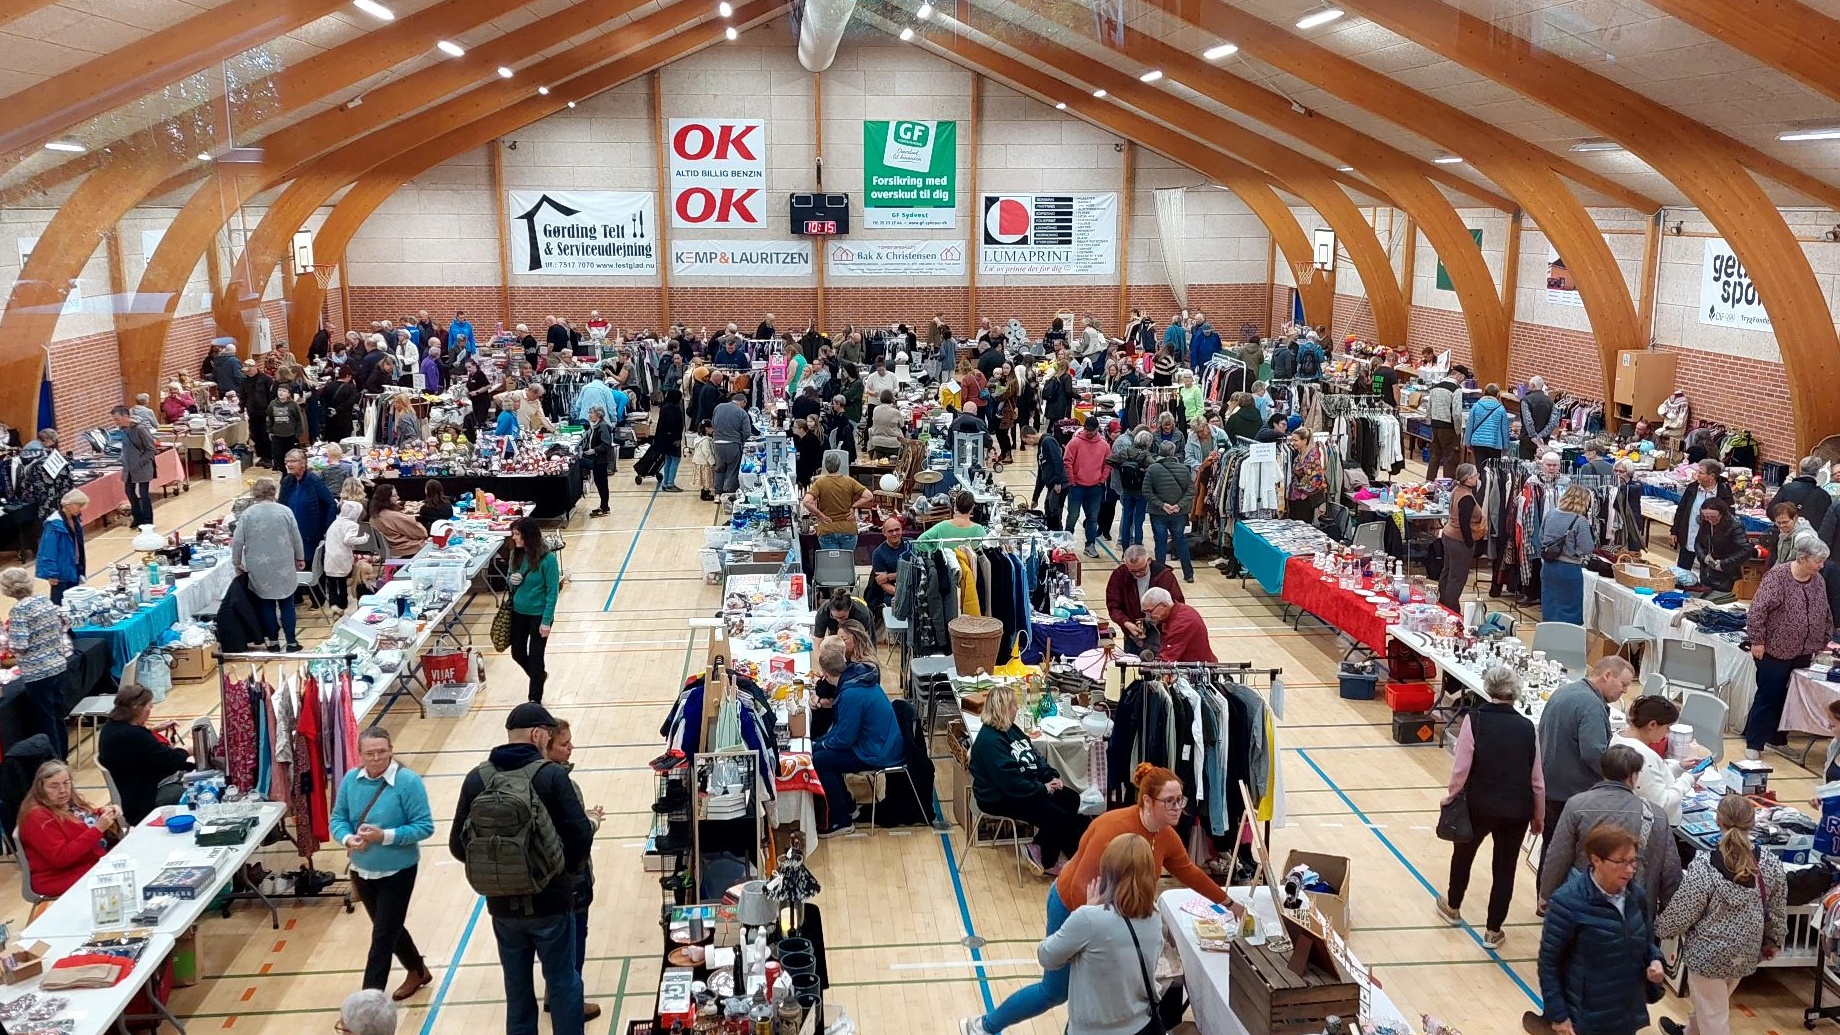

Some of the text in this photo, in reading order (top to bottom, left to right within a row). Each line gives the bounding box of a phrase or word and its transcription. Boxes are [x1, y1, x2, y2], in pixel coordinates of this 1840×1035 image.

[899, 123, 925, 141] GF
[673, 124, 760, 160] OK
[872, 176, 947, 188] Forsikring med
[871, 189, 949, 201] overskud til dig
[675, 187, 761, 223] OK
[543, 223, 626, 240] Gørding Telt
[808, 222, 834, 233] 10:15
[544, 242, 653, 258] & Serviceudlejning
[857, 251, 937, 260] Bak & Christensen
[984, 250, 1073, 262] LUMAPRINT
